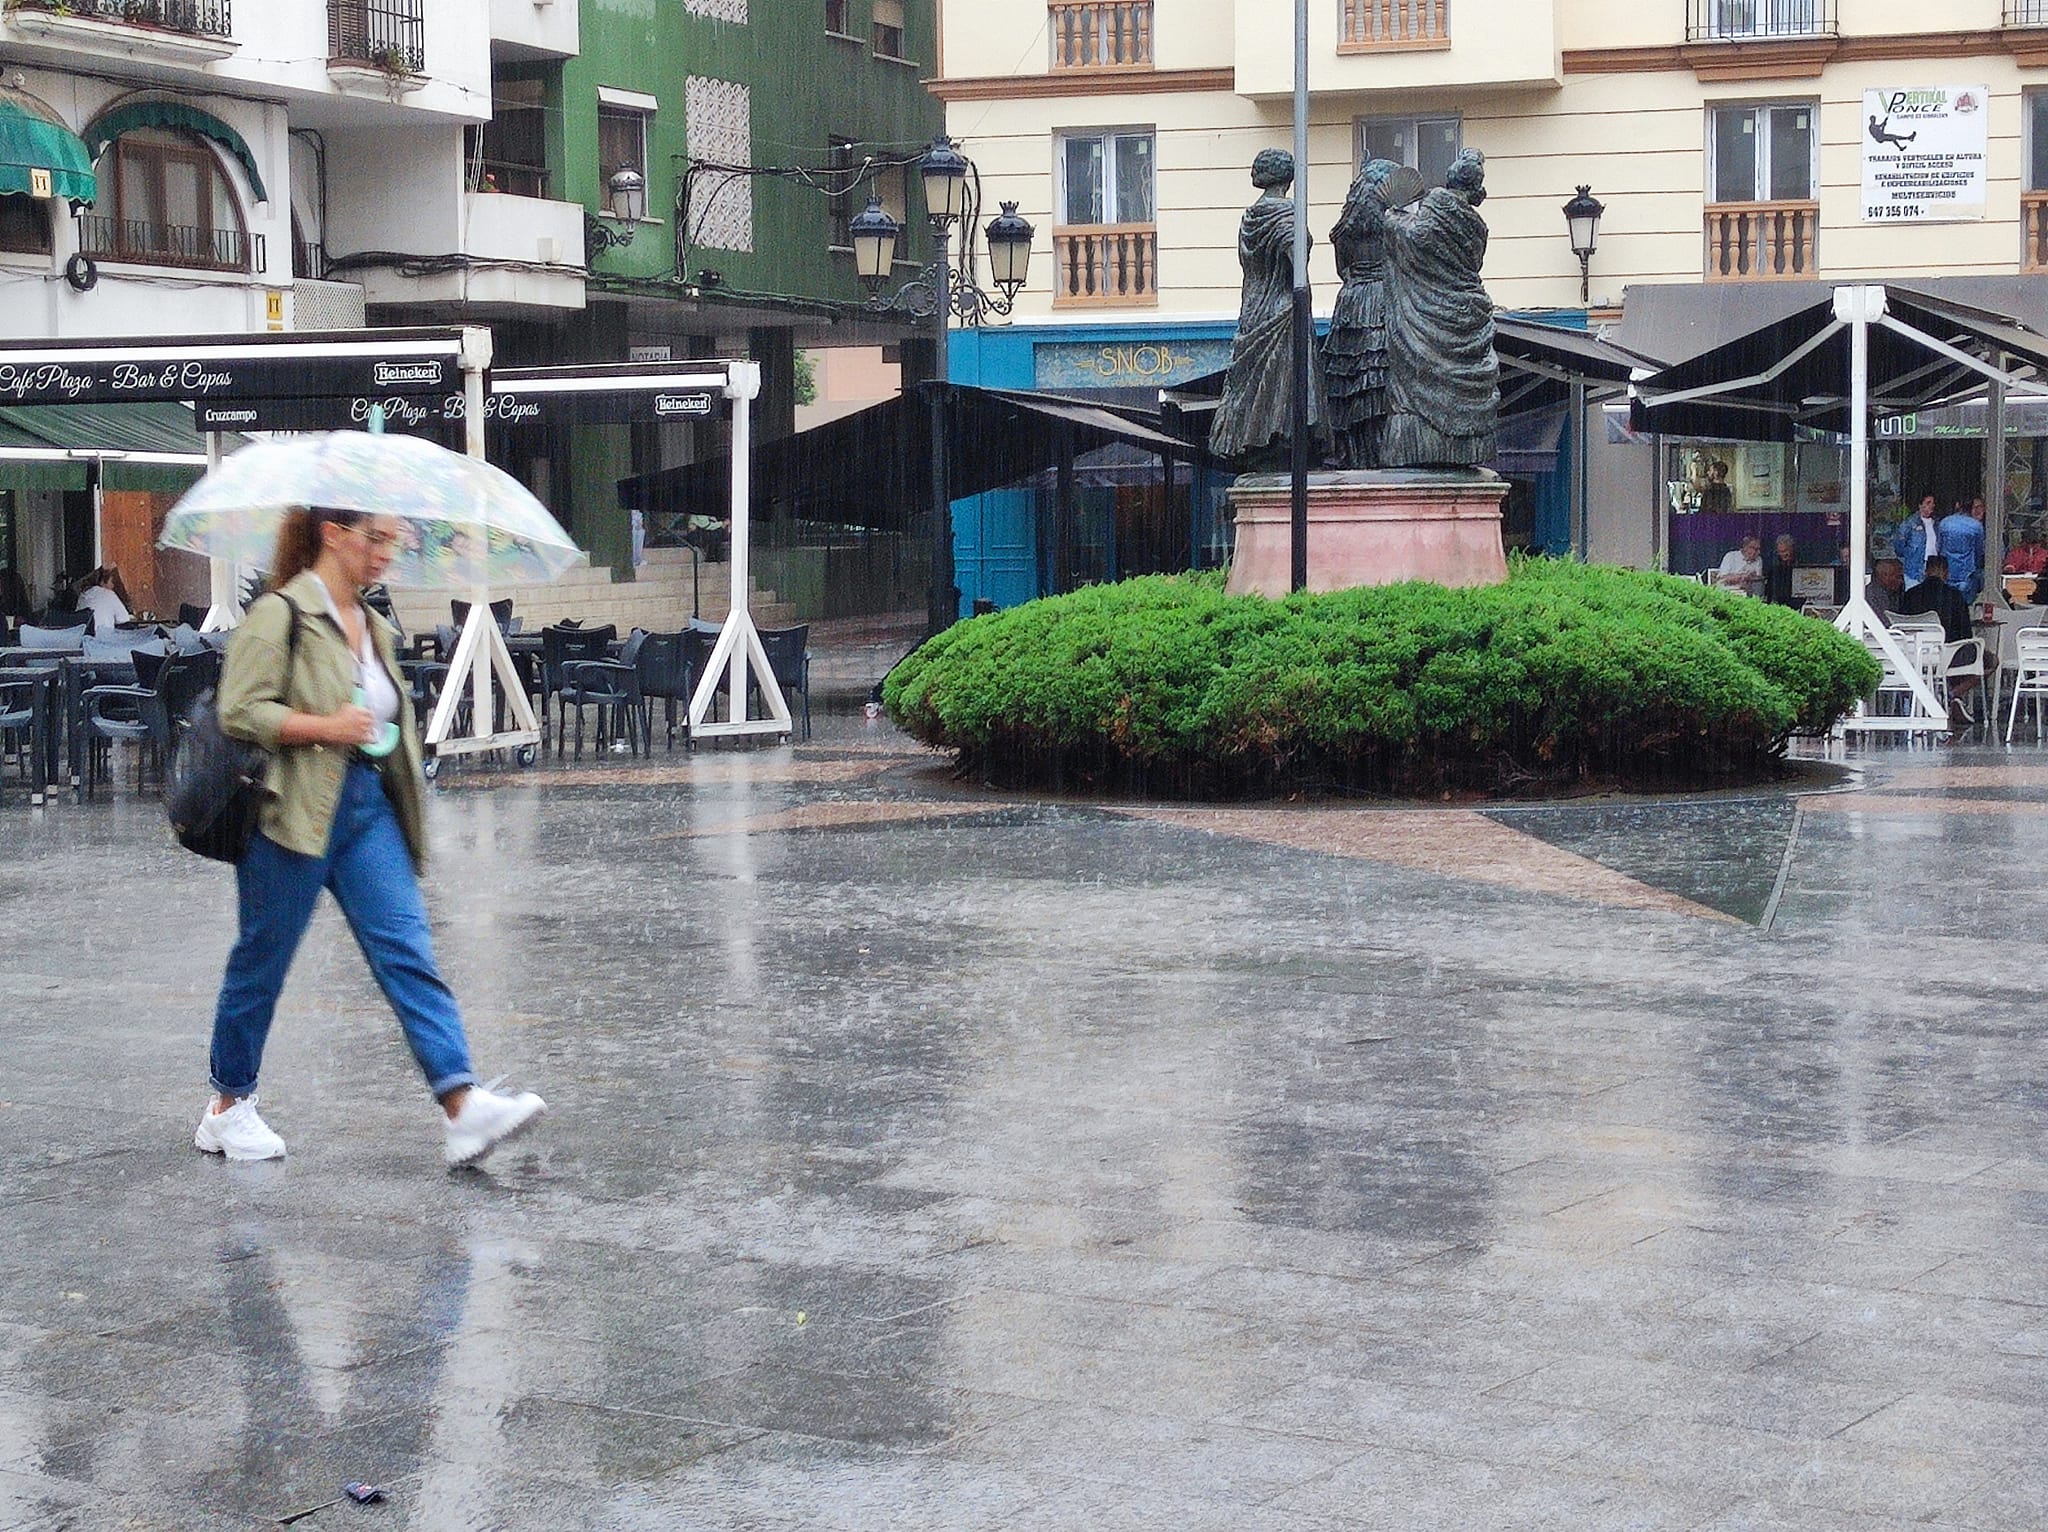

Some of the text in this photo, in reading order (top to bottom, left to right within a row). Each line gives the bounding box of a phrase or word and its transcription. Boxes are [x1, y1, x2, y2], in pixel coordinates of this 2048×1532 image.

[1888, 92, 1944, 114] PONCE
[1868, 206, 1884, 217] 647
[1903, 205, 1919, 216] 074
[1099, 346, 1173, 376] SNOB
[0, 365, 33, 398] Café
[36, 364, 93, 397] Plaza
[112, 364, 156, 389] Bar
[160, 365, 178, 388] &
[181, 362, 232, 393] Copas
[379, 366, 438, 380] Heineken
[384, 397, 427, 426] Plaza
[499, 394, 540, 423] Copas
[659, 398, 708, 410] Heineken
[206, 408, 257, 423] Cruzcampo
